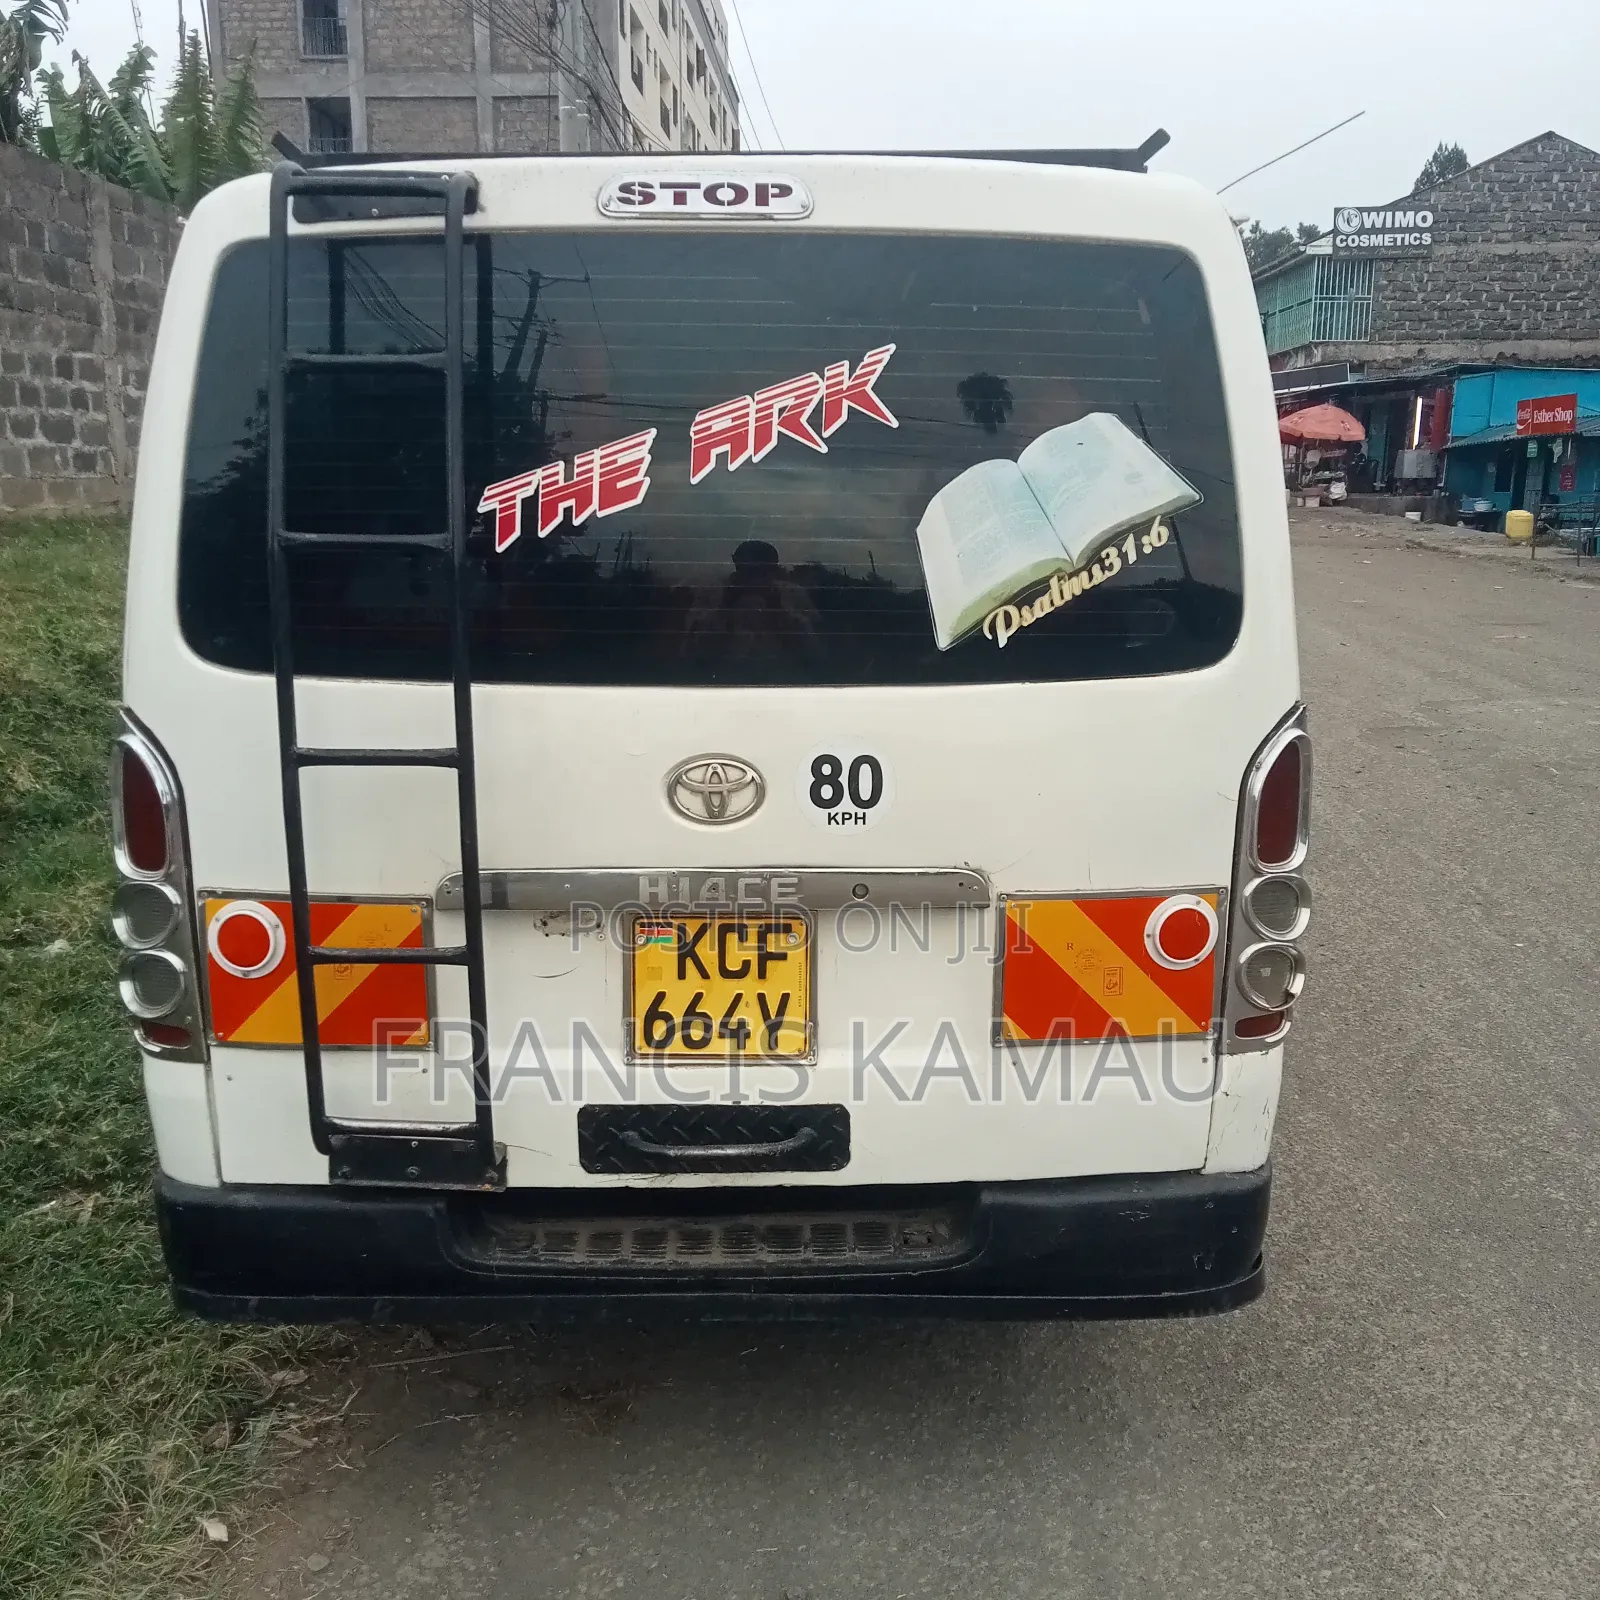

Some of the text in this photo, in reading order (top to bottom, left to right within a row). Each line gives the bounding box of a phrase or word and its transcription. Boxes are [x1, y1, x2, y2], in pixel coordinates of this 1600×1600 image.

[616, 181, 794, 207] STOP
[1361, 210, 1434, 229] WIMO
[1335, 232, 1432, 248] COSMETICS
[1533, 408, 1554, 424] Esther
[1554, 406, 1573, 424] Shop
[477, 343, 899, 553] THE ARK
[809, 754, 884, 810] 80
[826, 812, 867, 826] KPH
[638, 875, 801, 904] HIACE
[676, 922, 793, 981] KCF
[642, 990, 791, 1051] 664Y
